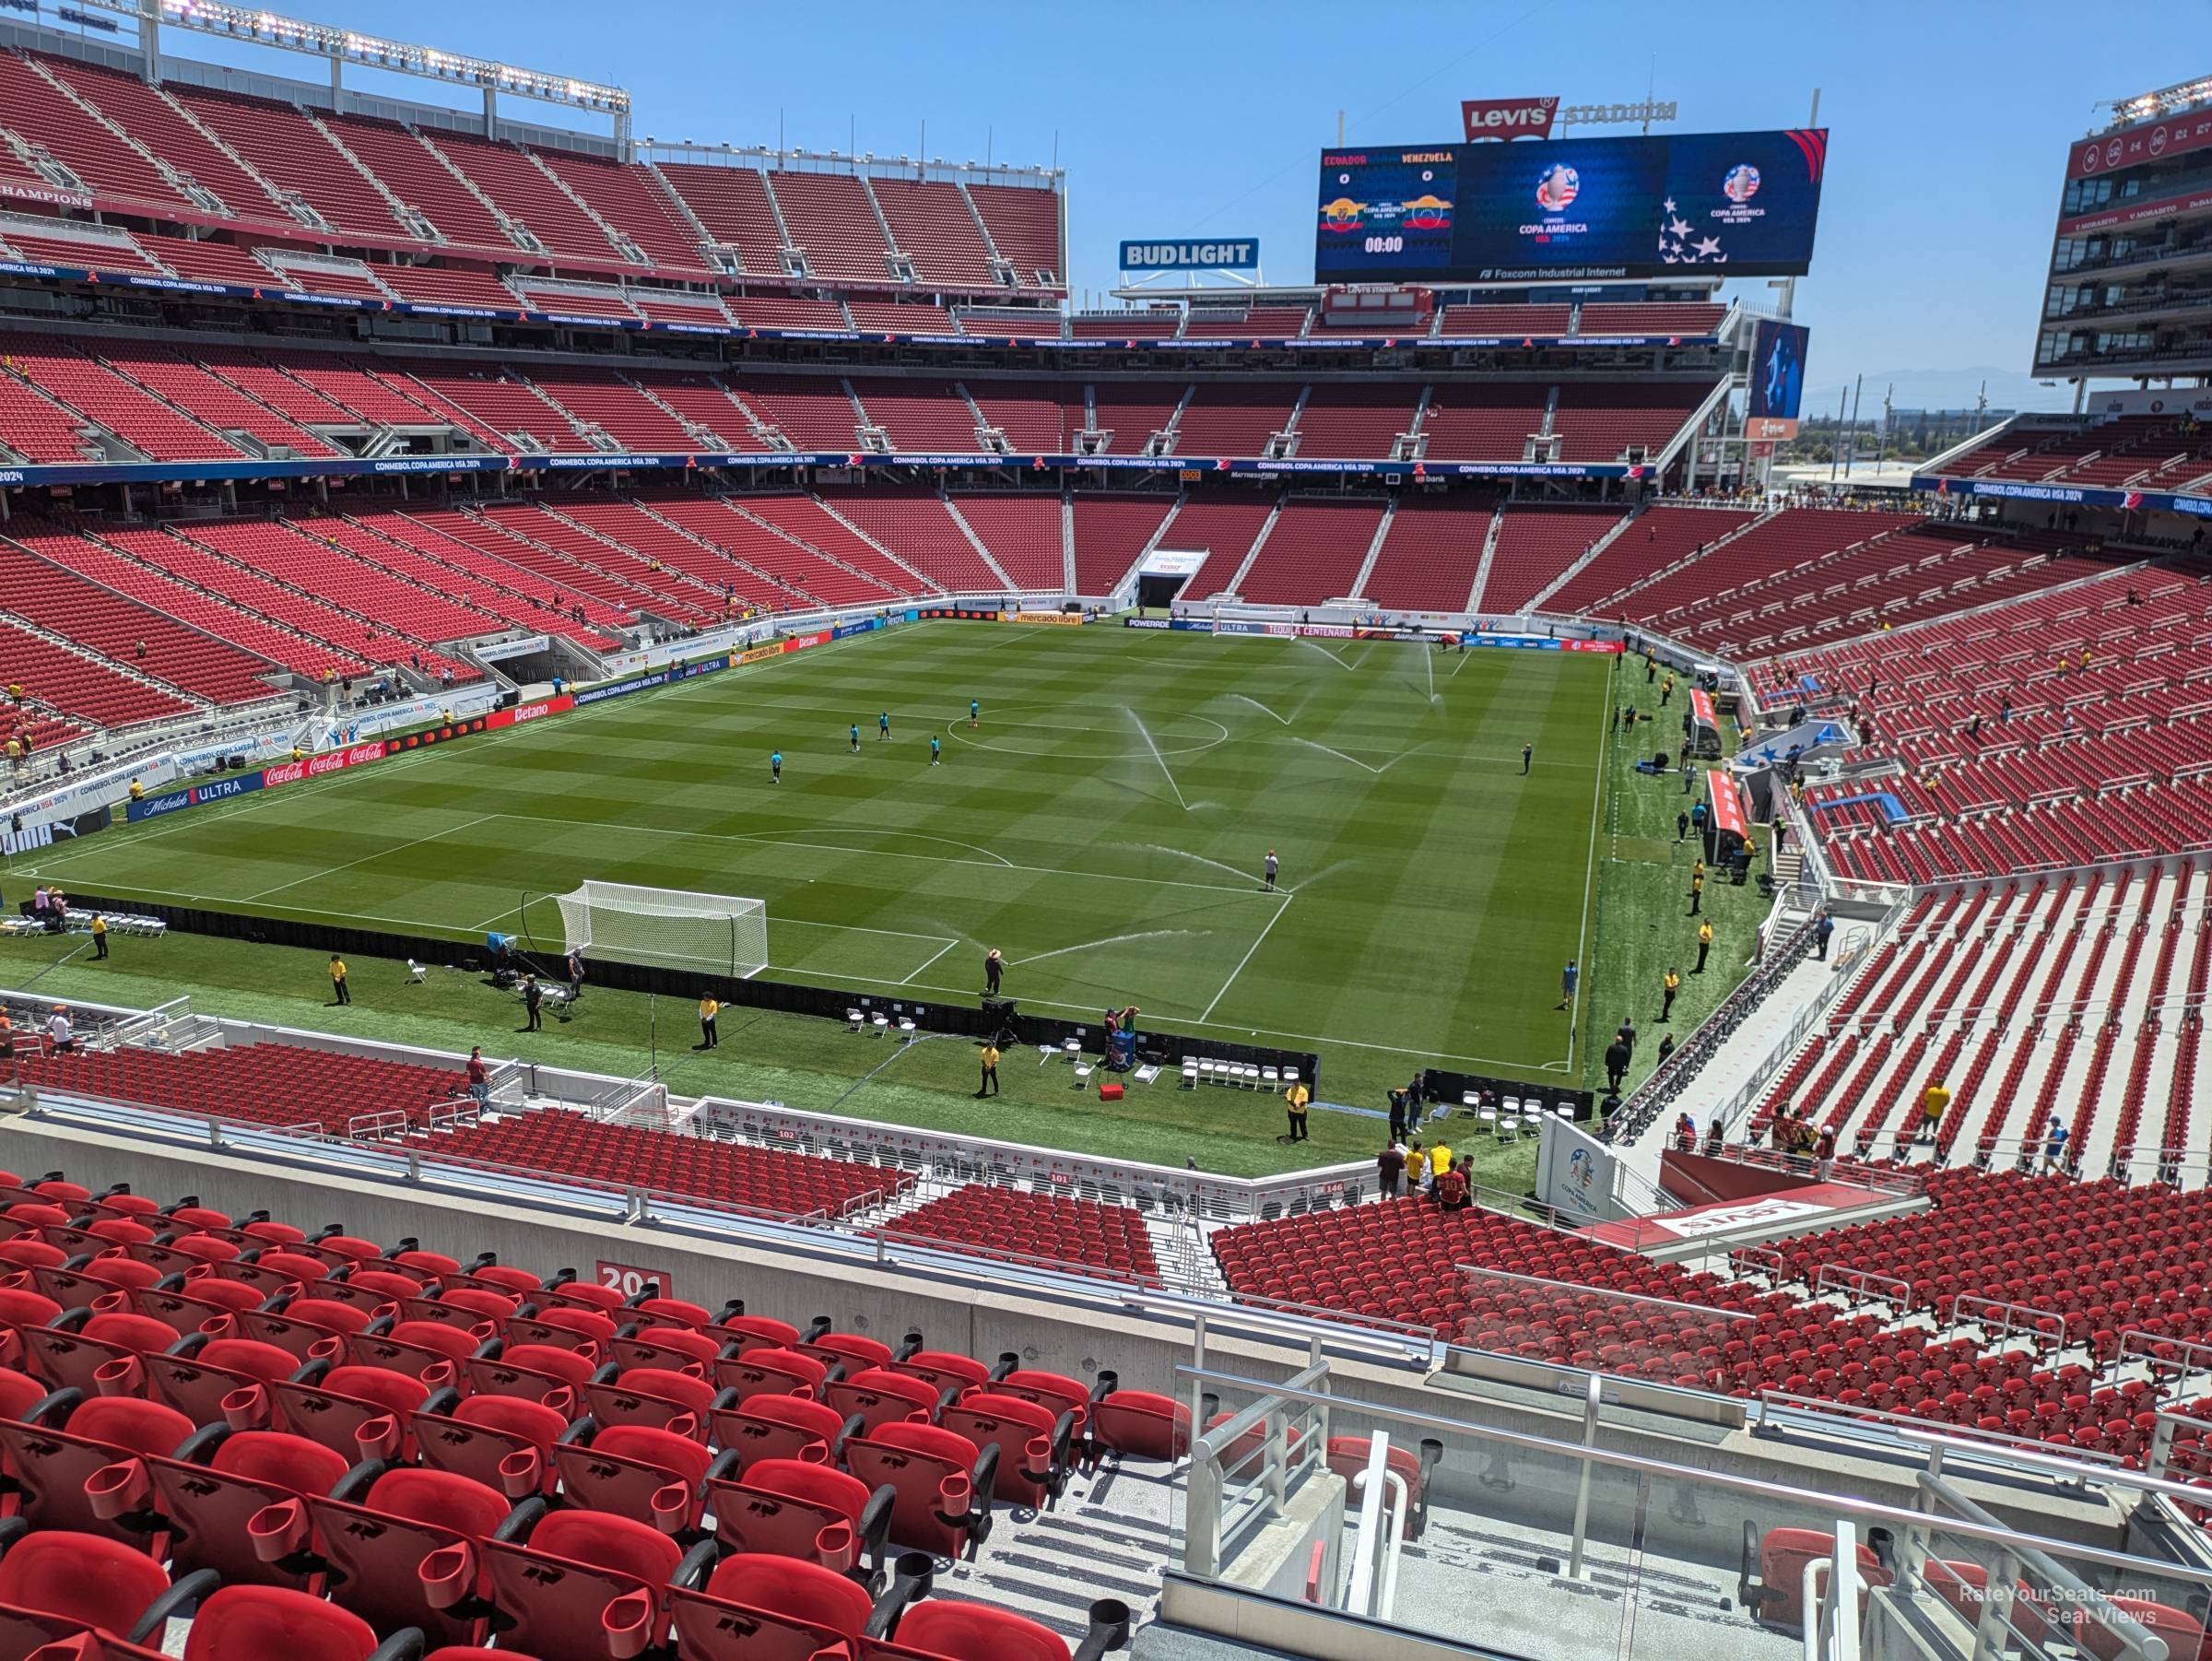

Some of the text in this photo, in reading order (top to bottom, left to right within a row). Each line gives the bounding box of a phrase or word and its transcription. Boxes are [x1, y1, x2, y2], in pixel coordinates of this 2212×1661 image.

[1566, 101, 1677, 125] STADIUM
[1324, 152, 1453, 166] ECUADOR VENEZUELA
[1339, 171, 1433, 184] 0 0
[0, 183, 93, 208] HAMPIONS
[1519, 222, 1587, 234] COPA AMERICA
[1365, 237, 1403, 253] 00:00
[1126, 244, 1250, 265] BUD LIGHT
[26, 265, 55, 276] USA 2024
[1495, 266, 1626, 278] Foxconn Industrial Internet
[131, 277, 162, 287] CONMEBOL
[163, 280, 178, 289] COPA
[179, 282, 202, 290] AMERICA
[376, 462, 410, 470] CONMEBOL
[428, 461, 454, 469] AMERICA
[1519, 466, 1551, 475] AMERICA
[0, 471, 23, 482] 2024
[1974, 483, 2005, 496] CONMEBOL
[2006, 485, 2020, 497] COPA
[2020, 486, 2050, 500] AMERICA
[1020, 613, 1057, 623] mercado
[1058, 614, 1077, 624] libre
[1129, 618, 1170, 629] POWERADE
[1220, 624, 1248, 632] ULTRA
[1269, 624, 1300, 635] TEQUILA
[1303, 627, 1353, 637] CENTENARIO
[744, 645, 781, 661] mercado libre
[701, 660, 721, 673] ULTRA
[579, 688, 607, 703] CONMEBOL
[607, 684, 620, 696] COPA
[620, 679, 641, 692] AMERICA
[377, 711, 391, 720] COPA
[392, 706, 415, 717] AMERICA
[514, 703, 548, 723] Betano
[179, 751, 216, 766] CONMEBOL
[216, 747, 229, 757] COPA
[229, 740, 261, 753] AMERICA
[274, 735, 288, 744] 2024
[79, 757, 171, 795] CONMEBOL COPA AMERICA USA 2024
[41, 800, 53, 811] USA
[53, 795, 68, 806] 2024
[144, 781, 241, 817] Michelob ULTRA
[779, 1130, 794, 1139] 102
[1051, 1175, 1067, 1184] 101
[1327, 1184, 1343, 1193] 146
